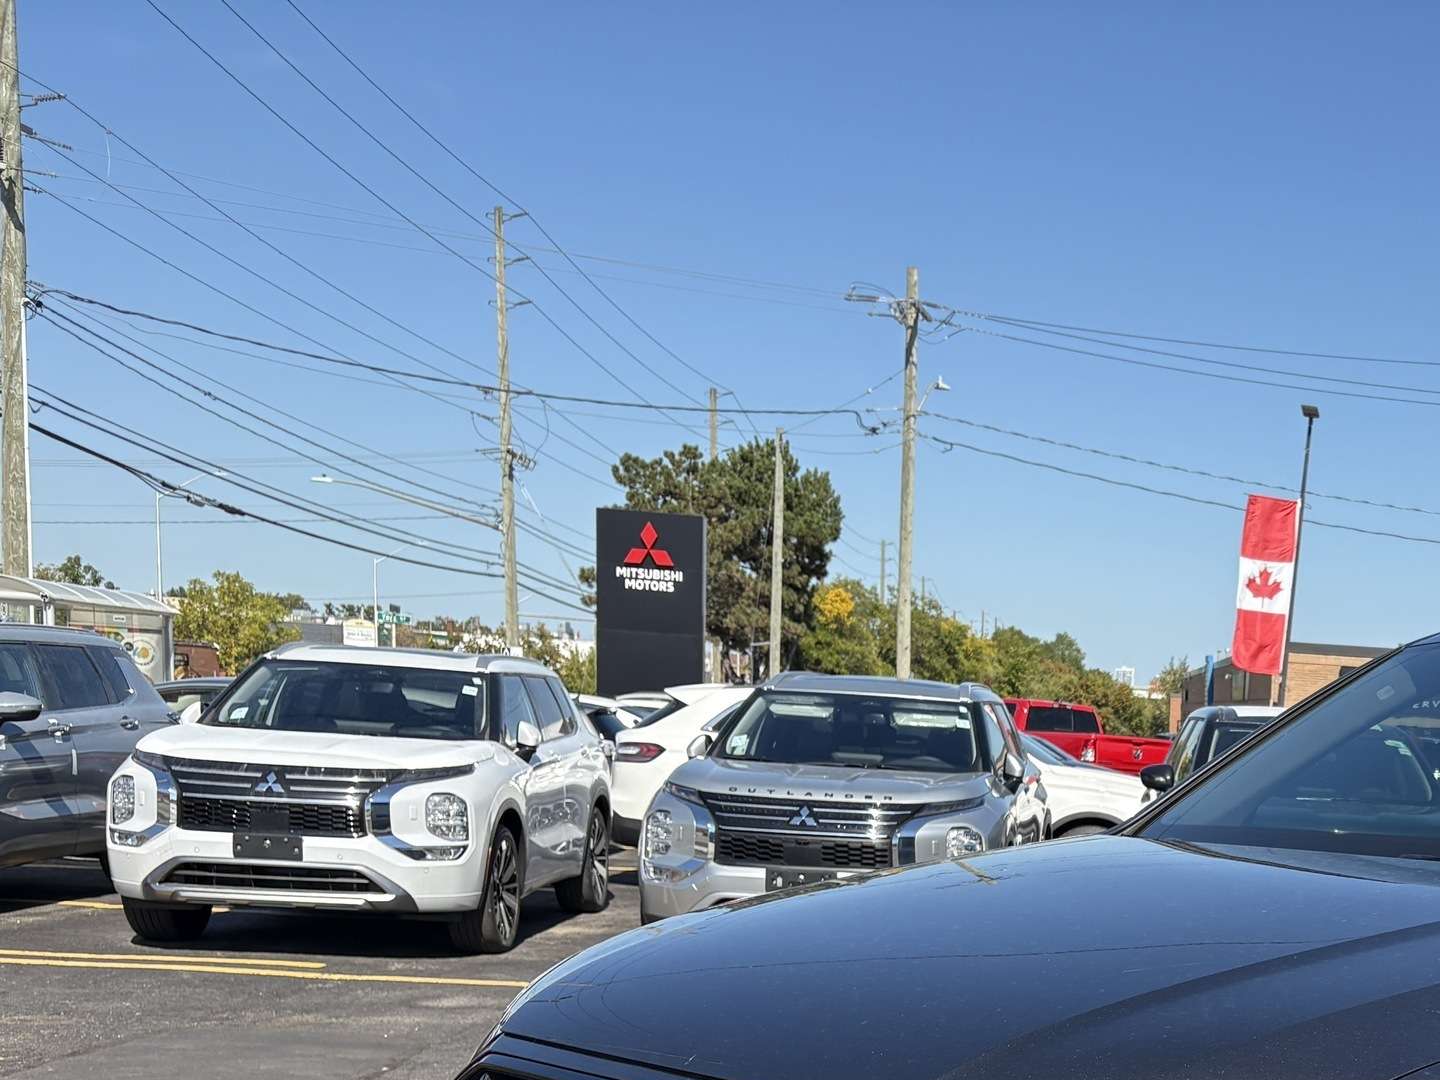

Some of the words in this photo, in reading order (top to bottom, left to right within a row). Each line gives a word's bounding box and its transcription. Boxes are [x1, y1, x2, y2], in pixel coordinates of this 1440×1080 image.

[615, 566, 683, 582] MITSUBISHI
[624, 578, 674, 592] MOTORS
[728, 786, 893, 801] OUTLANDER
